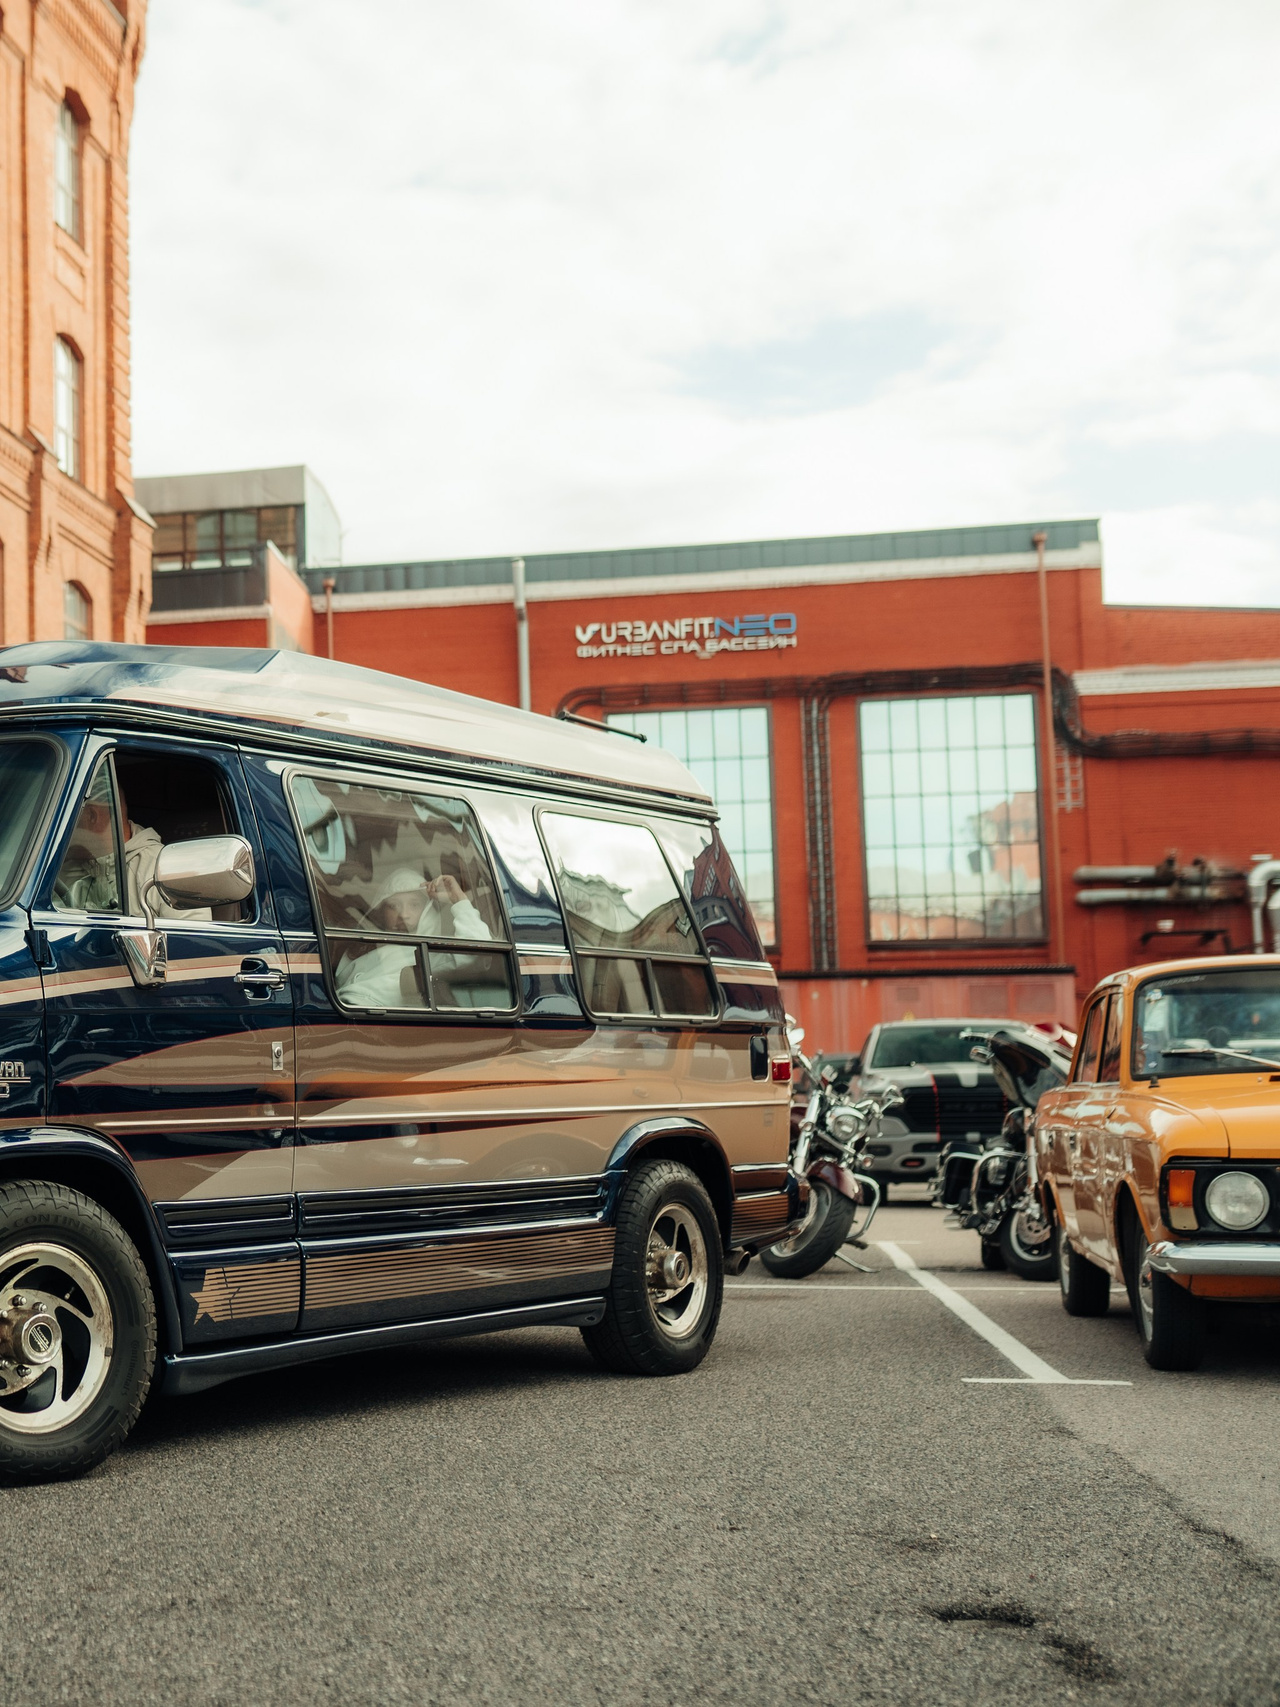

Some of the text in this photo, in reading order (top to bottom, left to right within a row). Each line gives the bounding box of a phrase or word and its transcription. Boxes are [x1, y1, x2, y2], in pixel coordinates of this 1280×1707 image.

[576, 634, 798, 658] ФИТНЕС СПА БАССЕЙН
